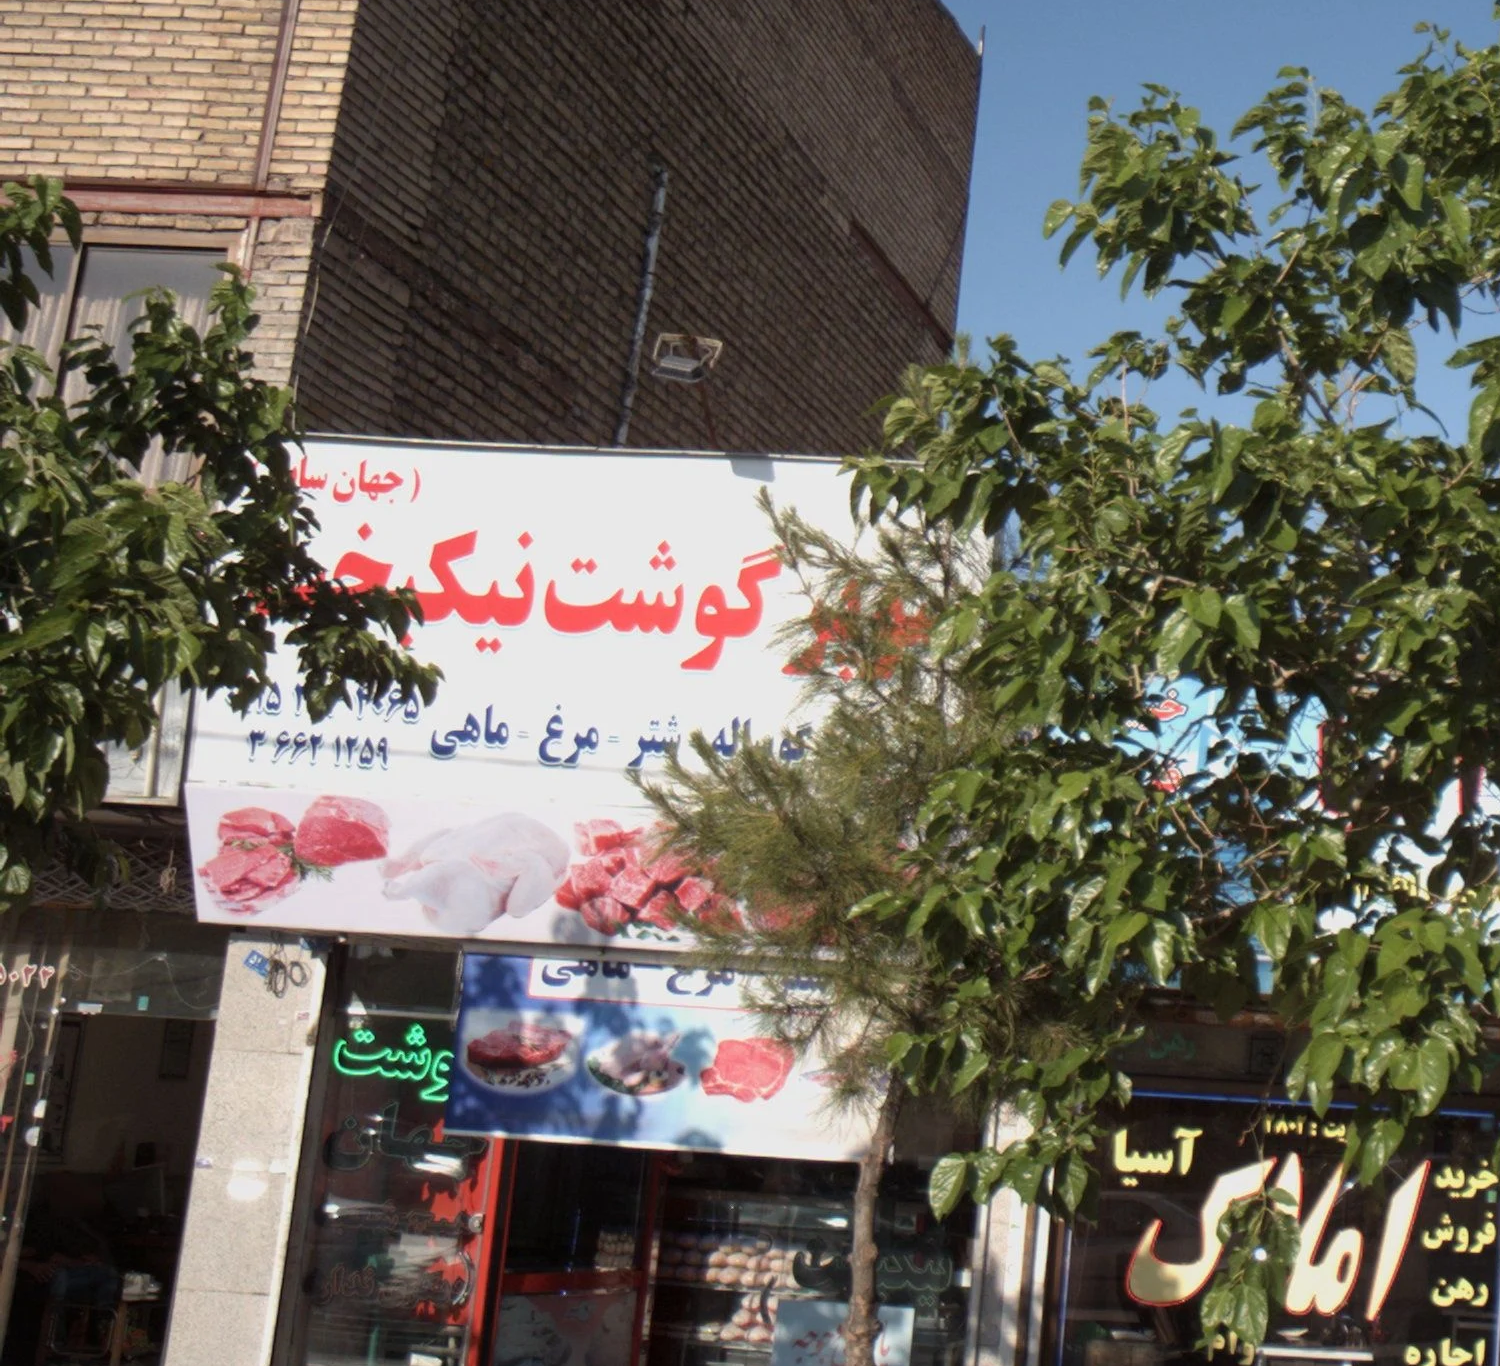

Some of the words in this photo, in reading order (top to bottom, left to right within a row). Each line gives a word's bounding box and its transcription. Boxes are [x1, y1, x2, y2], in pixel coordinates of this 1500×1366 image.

[543, 539, 786, 672] گوشت
[430, 704, 511, 757] ماهی
[538, 704, 600, 767] مرغ
[627, 714, 682, 769] شتر
[333, 1023, 457, 1102] وشت
[1112, 1128, 1203, 1187] آسیا
[1434, 1159, 1500, 1199] خرید
[1421, 1212, 1498, 1253] فروش
[1430, 1278, 1489, 1308] رهن
